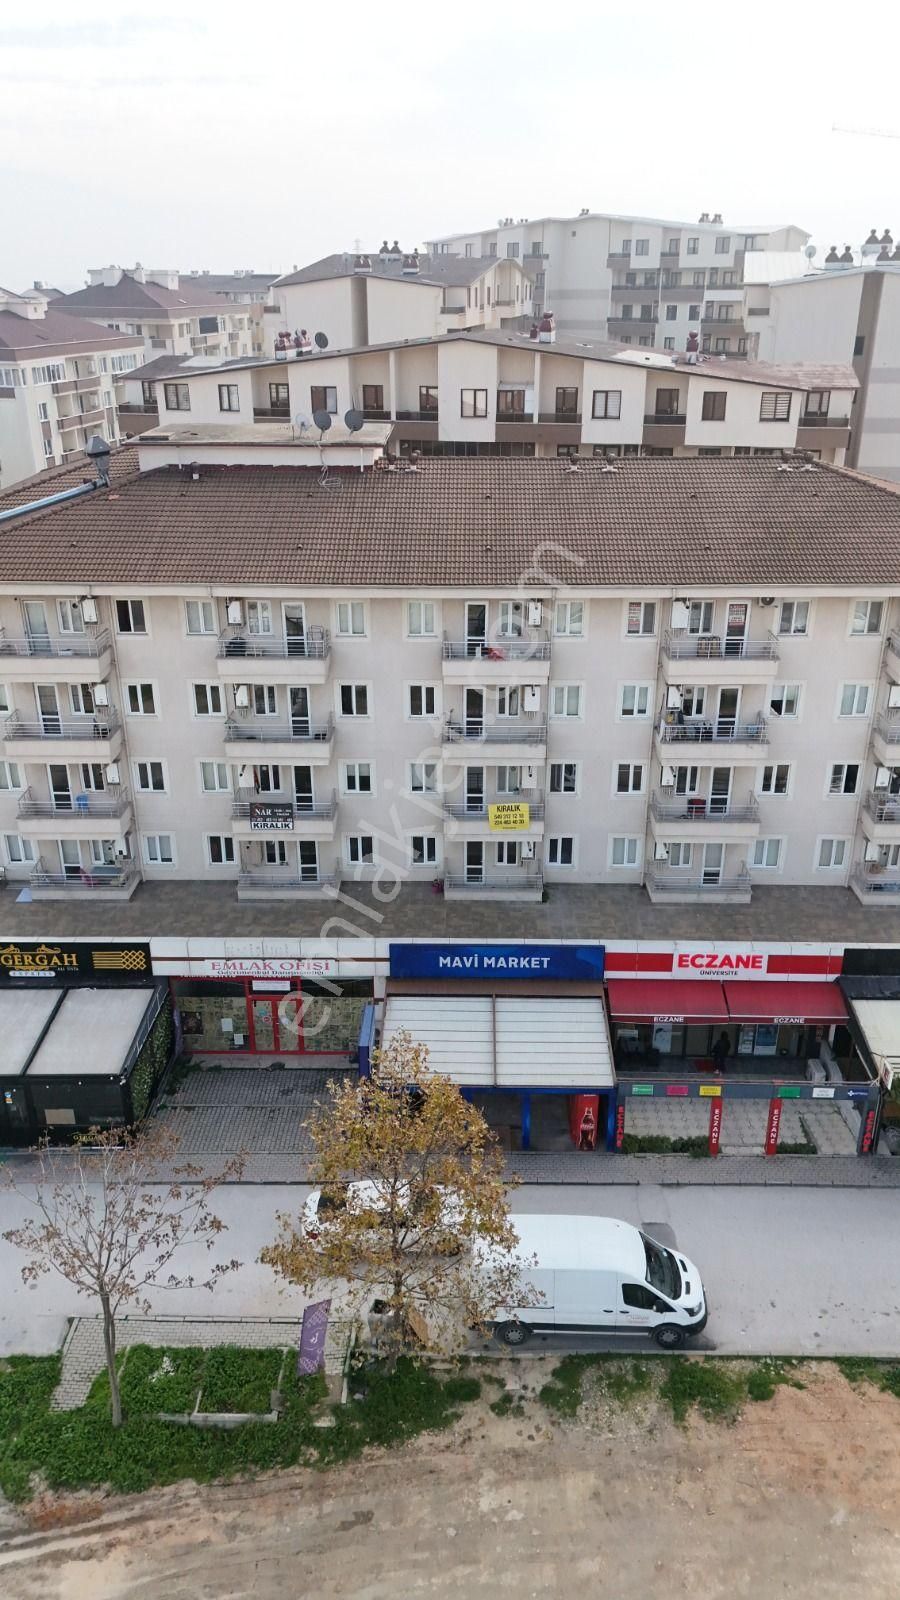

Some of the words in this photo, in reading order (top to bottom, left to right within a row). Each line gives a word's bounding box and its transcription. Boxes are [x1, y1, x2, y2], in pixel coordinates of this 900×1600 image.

[255, 808, 272, 816] NAR
[0, 953, 80, 966] GERGAH
[211, 962, 274, 970] EMLAK
[439, 954, 479, 968] MAVİ
[484, 957, 550, 968] MARKET
[677, 953, 763, 969] ECZANE
[616, 1105, 624, 1147] ECZANE
[711, 1109, 720, 1144] ECZANE
[770, 1109, 779, 1144] ECZANE
[863, 1111, 875, 1152] ECZANE
